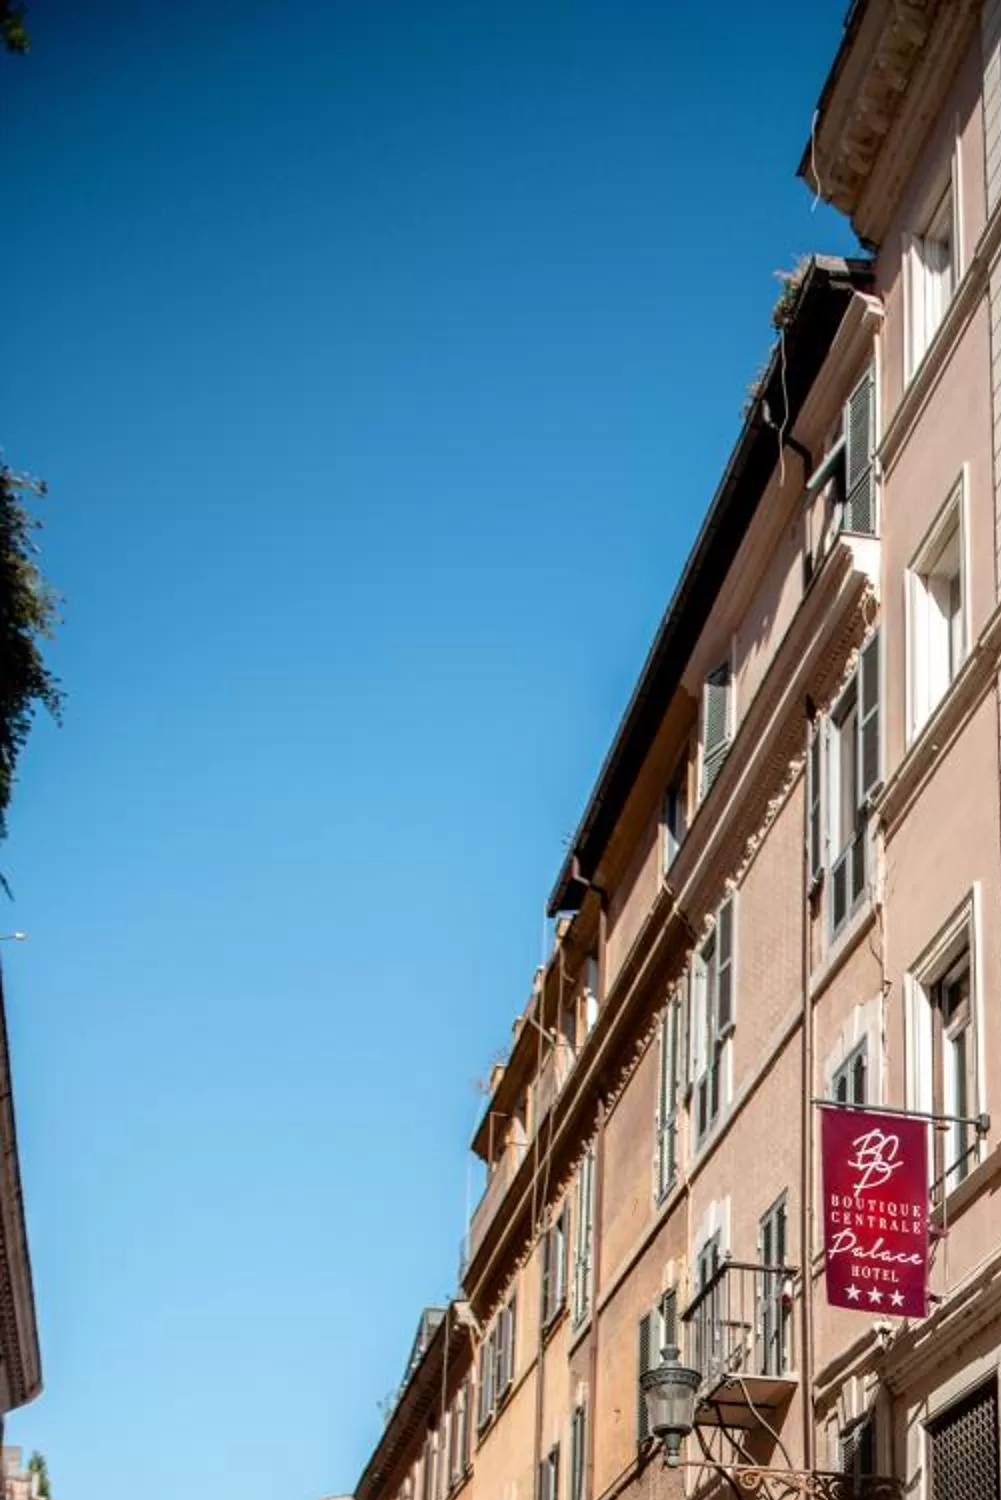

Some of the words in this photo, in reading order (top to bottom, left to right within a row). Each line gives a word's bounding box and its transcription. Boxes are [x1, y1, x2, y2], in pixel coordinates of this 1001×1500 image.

[831, 1194, 922, 1218] BOUTIQUE
[831, 1210, 922, 1234] CENTRALE
[829, 1227, 923, 1265] Palace
[851, 1264, 900, 1283] HOTEL
